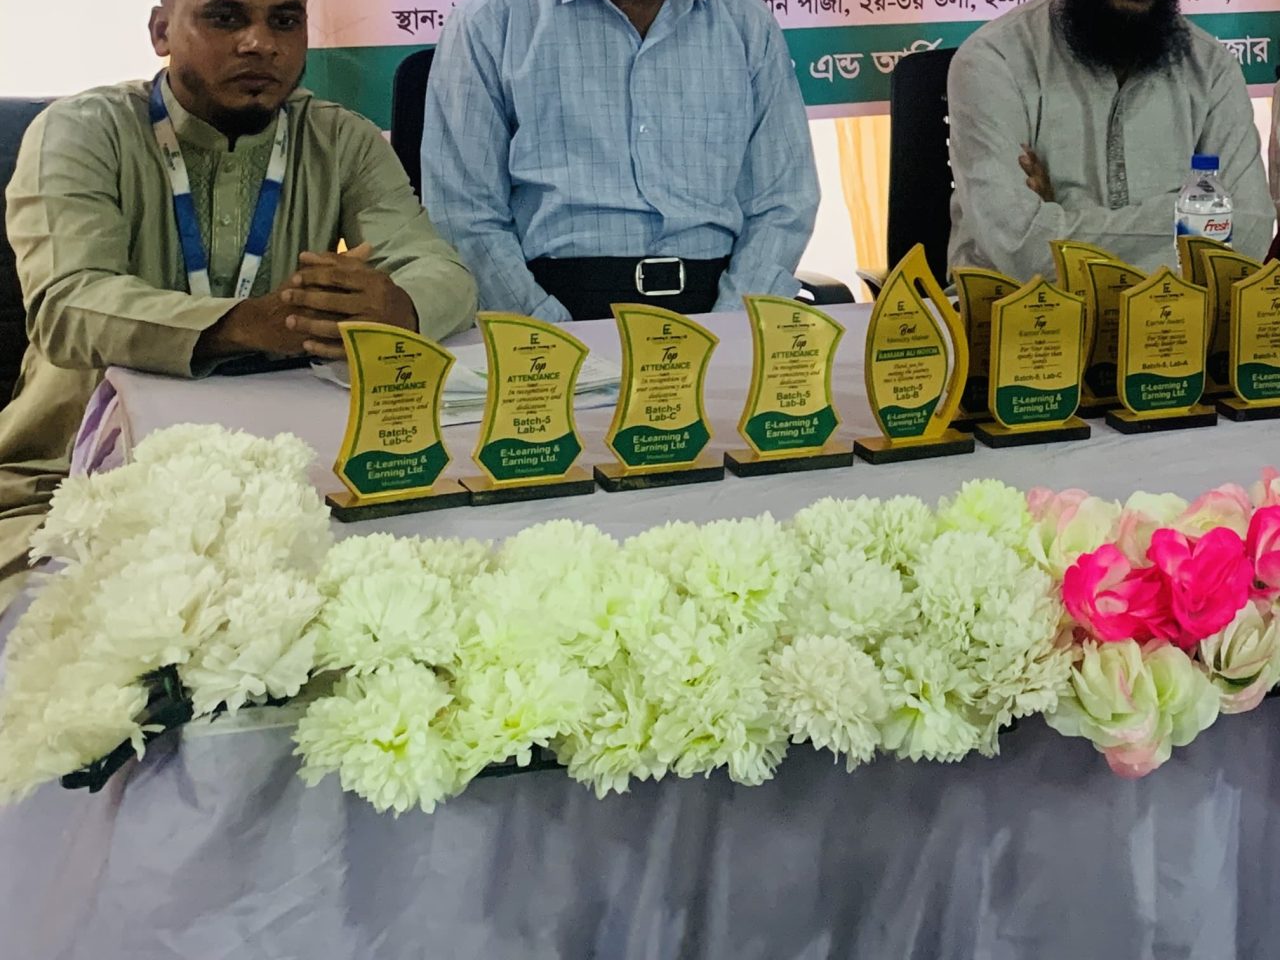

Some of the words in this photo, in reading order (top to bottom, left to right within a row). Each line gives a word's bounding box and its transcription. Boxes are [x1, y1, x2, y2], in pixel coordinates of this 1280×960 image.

[810, 52, 864, 83] এন্ড
[792, 334, 807, 351] Top
[662, 346, 678, 363] Top
[771, 349, 820, 359] ATTENDANCE
[530, 356, 546, 374] Top
[640, 361, 691, 372] ATTENDANCE
[395, 365, 413, 383] Top
[507, 372, 560, 383] ATTENDANCE
[371, 381, 427, 394] ATTENDANCE
[776, 390, 811, 400] Batch-5
[645, 404, 681, 415] Batch-5
[513, 416, 551, 427] Batch-5
[765, 419, 810, 429] E-Learning
[812, 417, 819, 425] &
[379, 426, 417, 438] Batch-5
[517, 424, 546, 434] Lab-A
[766, 428, 799, 438] Earning
[383, 435, 413, 446] Lab-C
[633, 433, 681, 443] E-Learning
[683, 431, 690, 439] &
[500, 446, 551, 457] E-Learning
[554, 444, 560, 452] &
[634, 442, 669, 452] Earning
[366, 457, 418, 470] E-Learning
[421, 455, 427, 463] &
[502, 456, 539, 466] Earning
[368, 468, 405, 480] Earning
